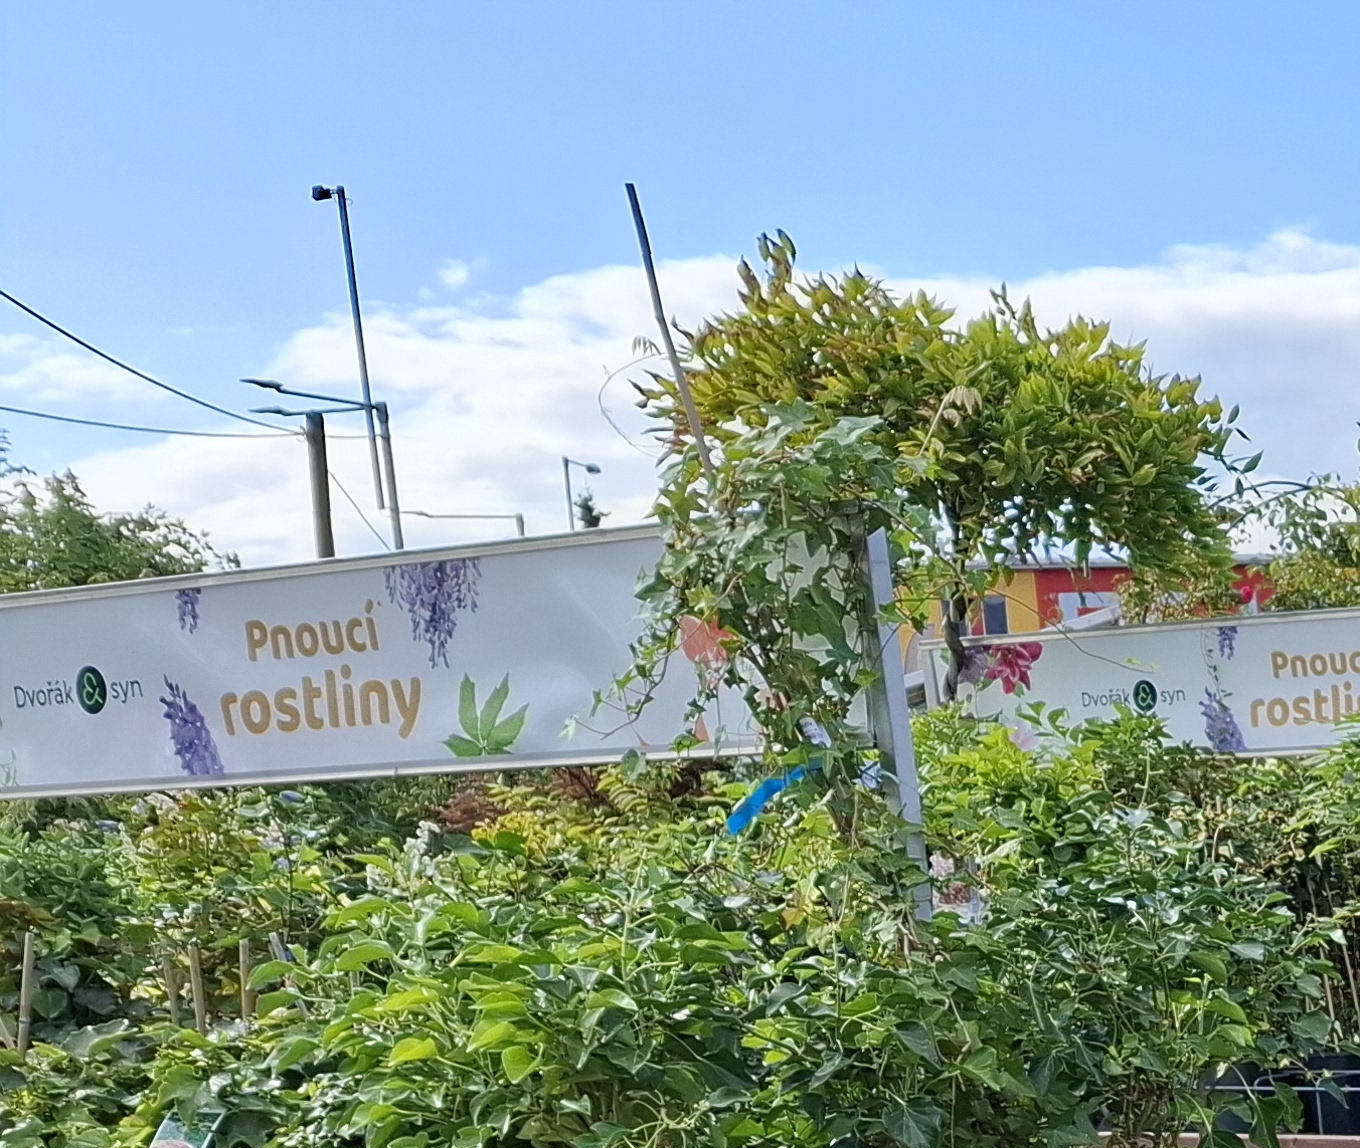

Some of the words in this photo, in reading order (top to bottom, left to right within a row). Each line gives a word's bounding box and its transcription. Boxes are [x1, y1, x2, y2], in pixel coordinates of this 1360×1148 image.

[244, 599, 380, 662] Pnoucí
[13, 681, 74, 709] Dvořák
[110, 677, 144, 700] syn
[218, 663, 422, 739] rostliny
[1160, 688, 1186, 706] syn
